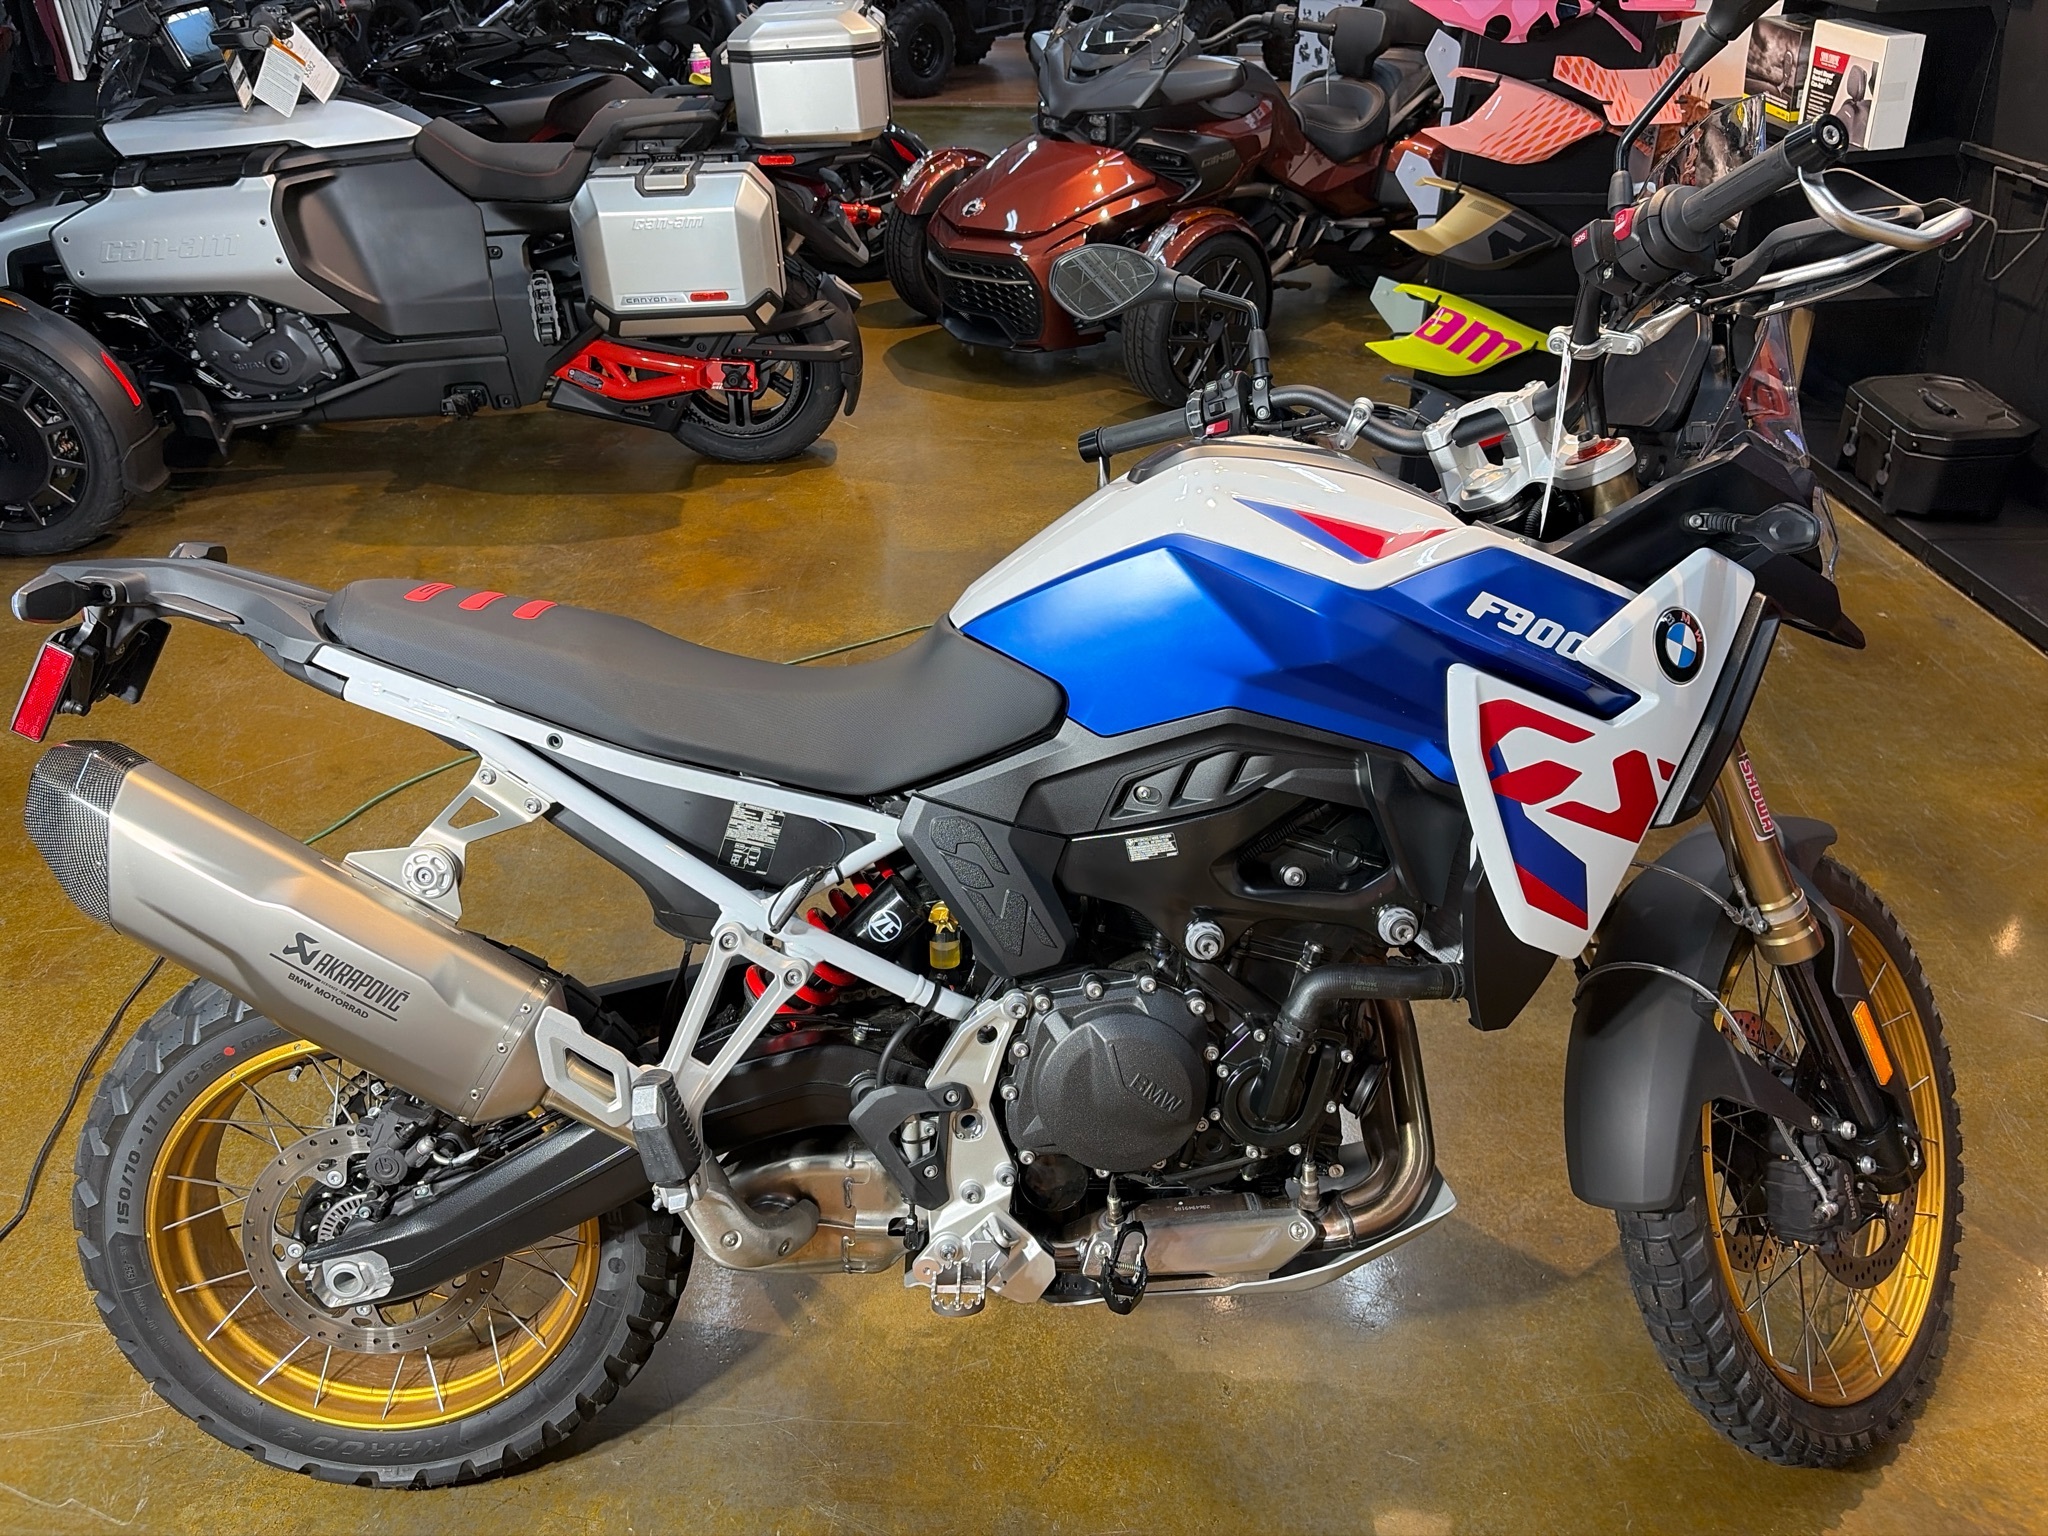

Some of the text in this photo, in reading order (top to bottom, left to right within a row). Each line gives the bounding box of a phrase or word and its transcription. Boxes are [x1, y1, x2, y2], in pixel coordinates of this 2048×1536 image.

[632, 215, 704, 231] can-am
[1574, 232, 1586, 245] SOS
[100, 233, 240, 264] can-am
[626, 296, 668, 304] CANYON
[1663, 611, 1703, 643] BMW
[1738, 758, 1775, 834] SHOWA
[287, 972, 369, 1019] BMW MOTORRAD
[1129, 1073, 1185, 1113] BMW
[1843, 1173, 1857, 1221] brembo
